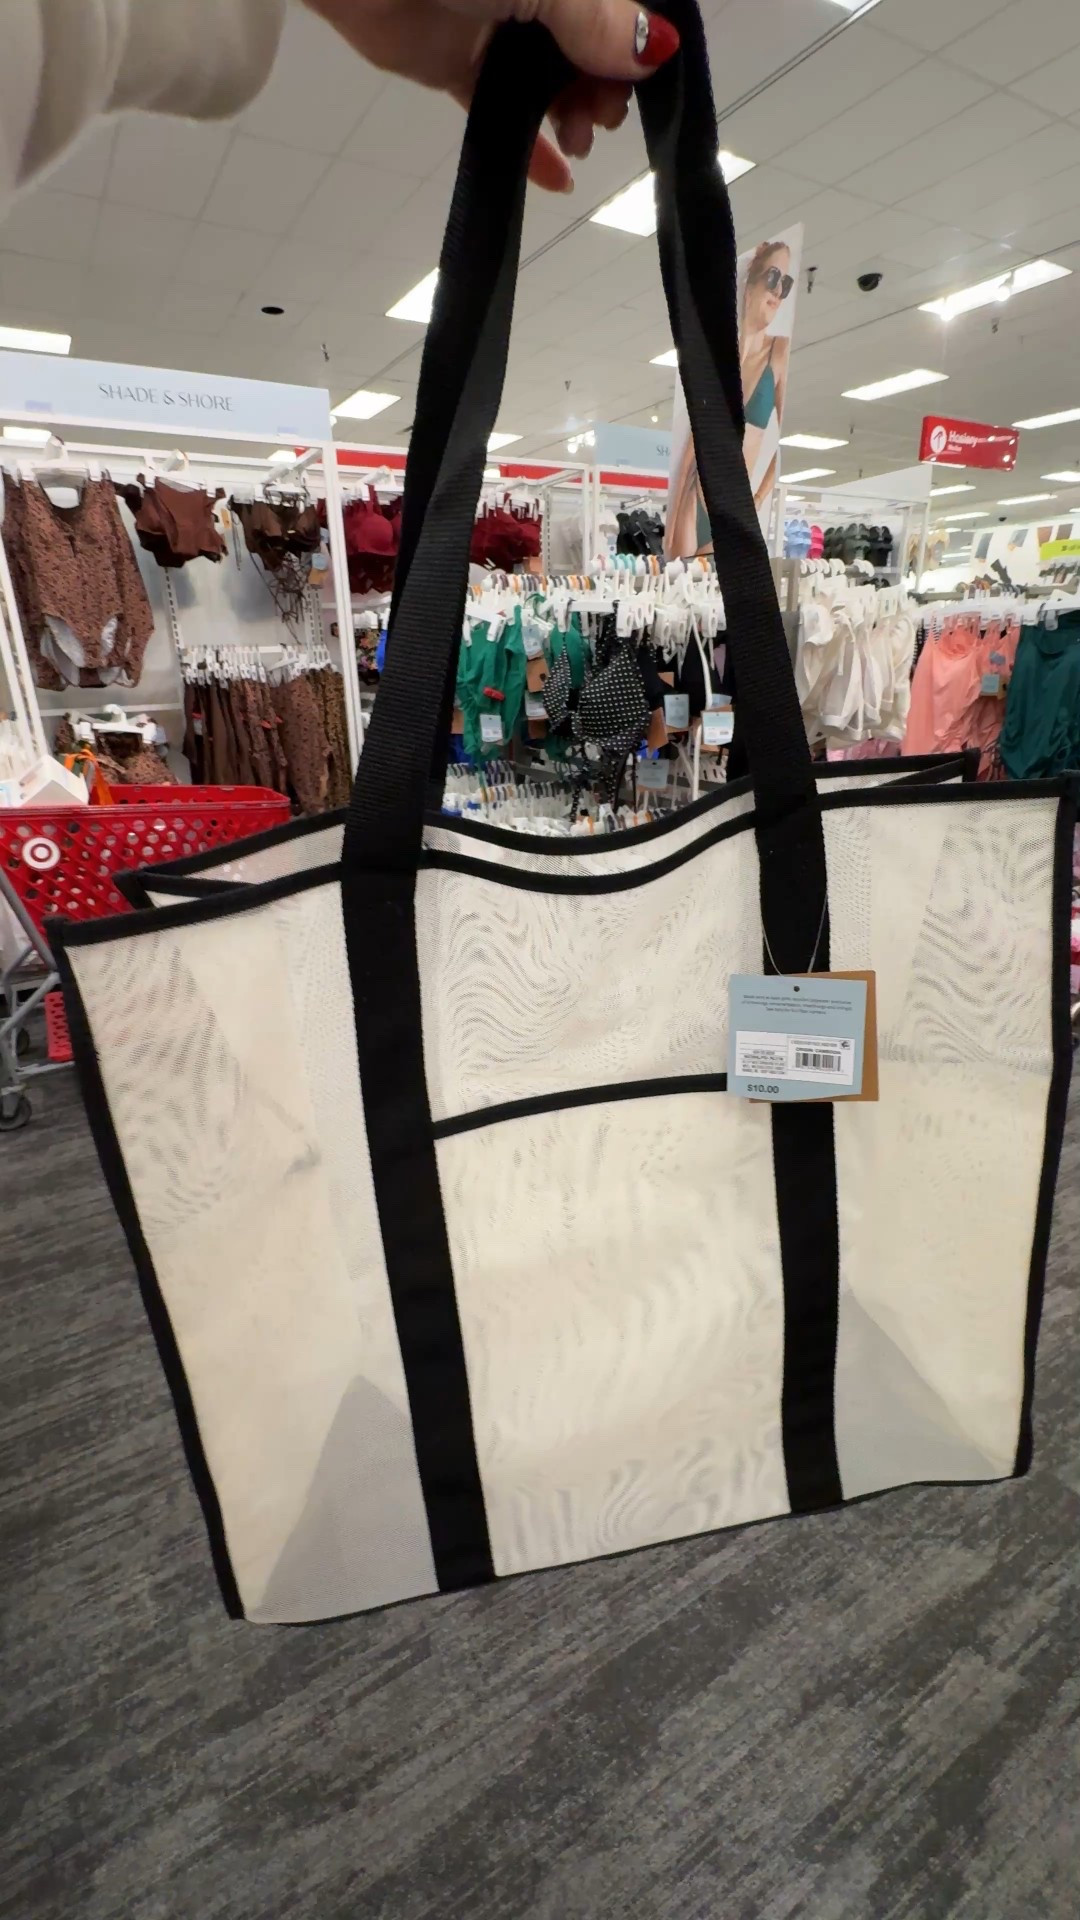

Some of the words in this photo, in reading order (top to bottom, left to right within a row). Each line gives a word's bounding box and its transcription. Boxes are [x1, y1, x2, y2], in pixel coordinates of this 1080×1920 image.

[98, 384, 158, 404] SHADE
[163, 390, 175, 406] &
[178, 391, 233, 412] SHORE
[747, 1084, 780, 1094] $10.00
